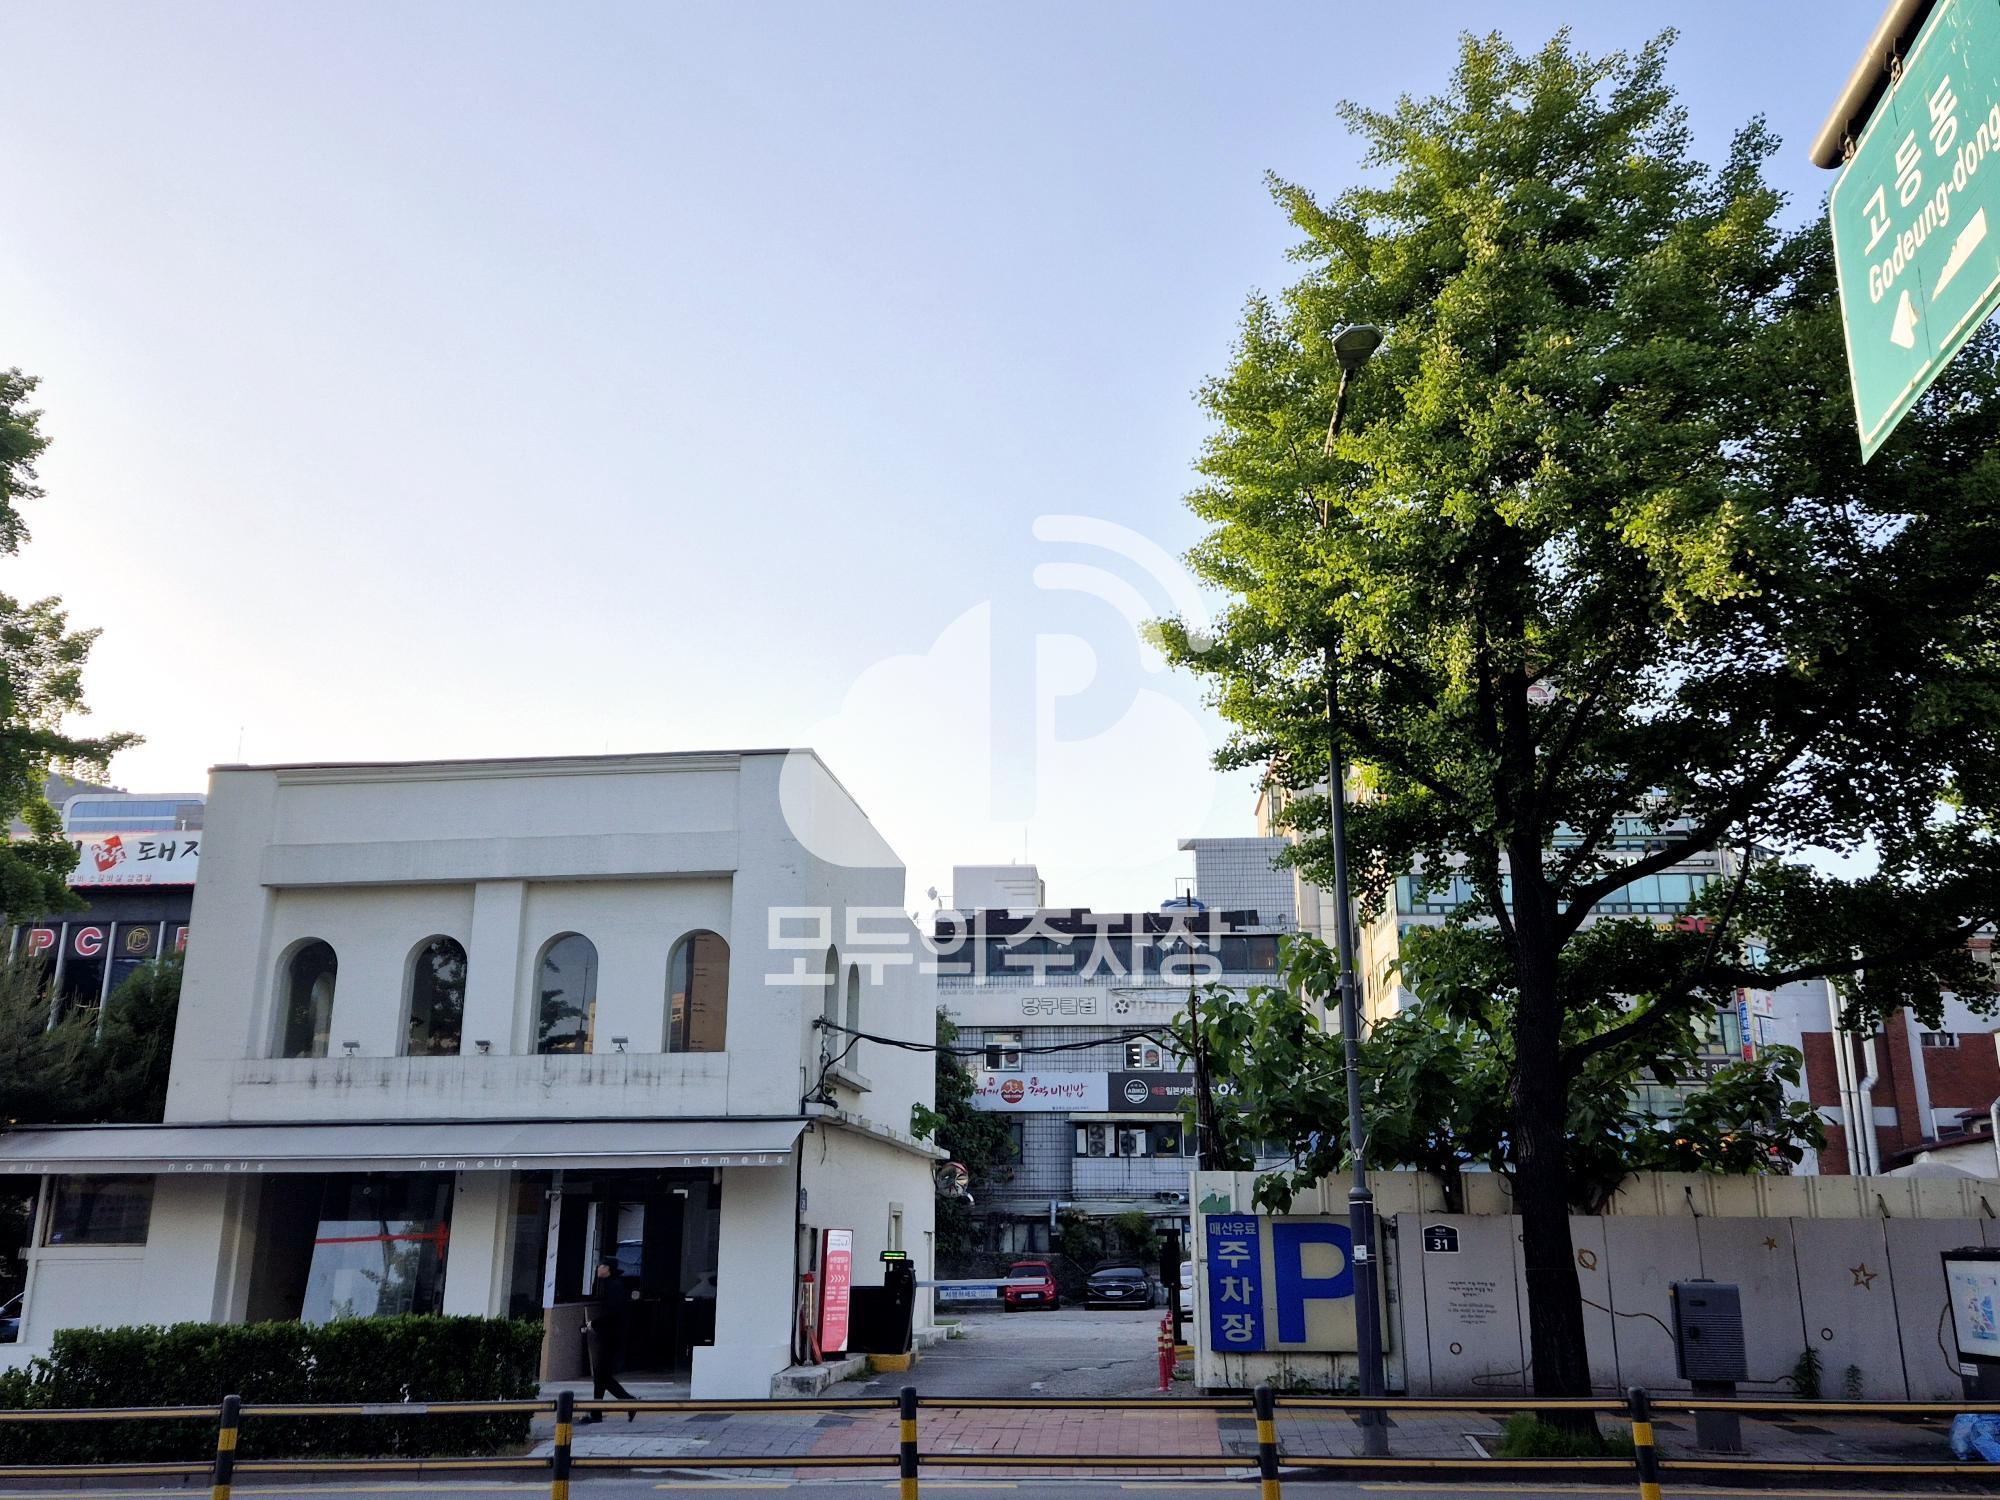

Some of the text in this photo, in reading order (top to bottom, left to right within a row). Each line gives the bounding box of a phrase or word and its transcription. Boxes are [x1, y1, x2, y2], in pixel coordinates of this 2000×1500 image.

[1863, 75, 1957, 256] 고등동
[1869, 101, 2000, 303] Godeung-dong
[1022, 997, 1097, 1015] 당구클럽
[1050, 1083, 1088, 1097] 비빔밥
[1209, 1222, 1257, 1236] 매산유료
[1433, 1238, 1449, 1250] 31
[1217, 1240, 1256, 1342] 주차장
[1272, 1223, 1355, 1343] P
